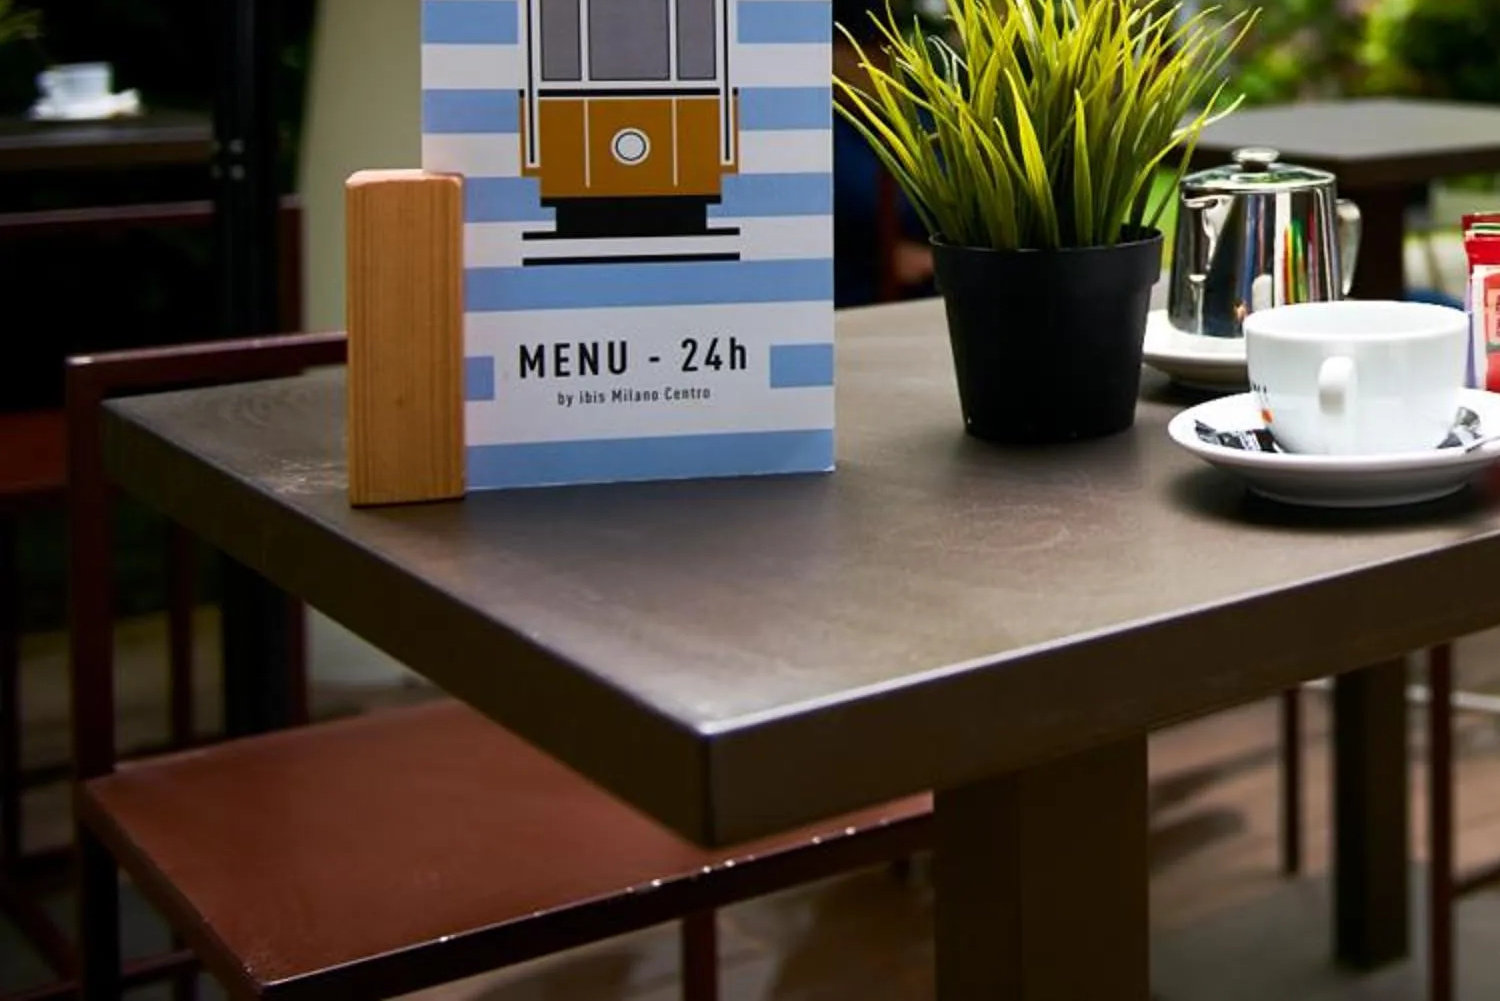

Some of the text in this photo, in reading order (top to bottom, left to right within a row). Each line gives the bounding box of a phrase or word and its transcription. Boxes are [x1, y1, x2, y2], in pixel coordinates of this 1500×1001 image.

[518, 340, 628, 379] MENU
[680, 336, 747, 373] 24h
[557, 386, 711, 408] by ibis Milano Centro
